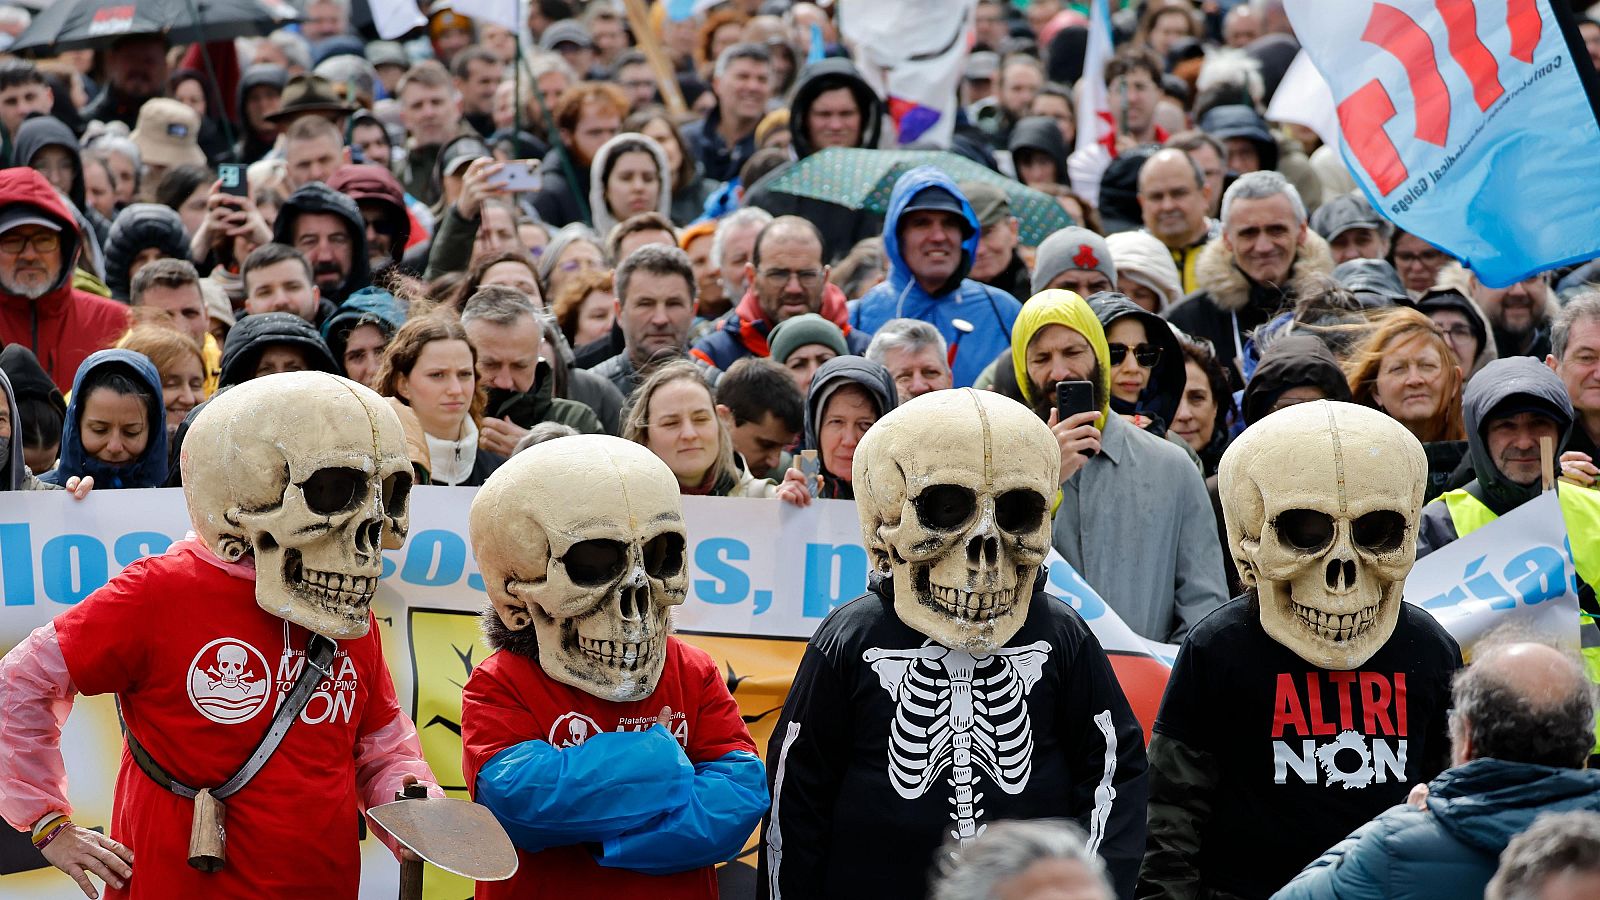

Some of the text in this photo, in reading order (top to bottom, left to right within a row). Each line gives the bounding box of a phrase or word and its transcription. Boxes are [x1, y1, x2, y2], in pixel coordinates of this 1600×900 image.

[334, 680, 357, 691] PINO
[1271, 671, 1408, 737] ALTRI
[1273, 730, 1408, 790] NON
